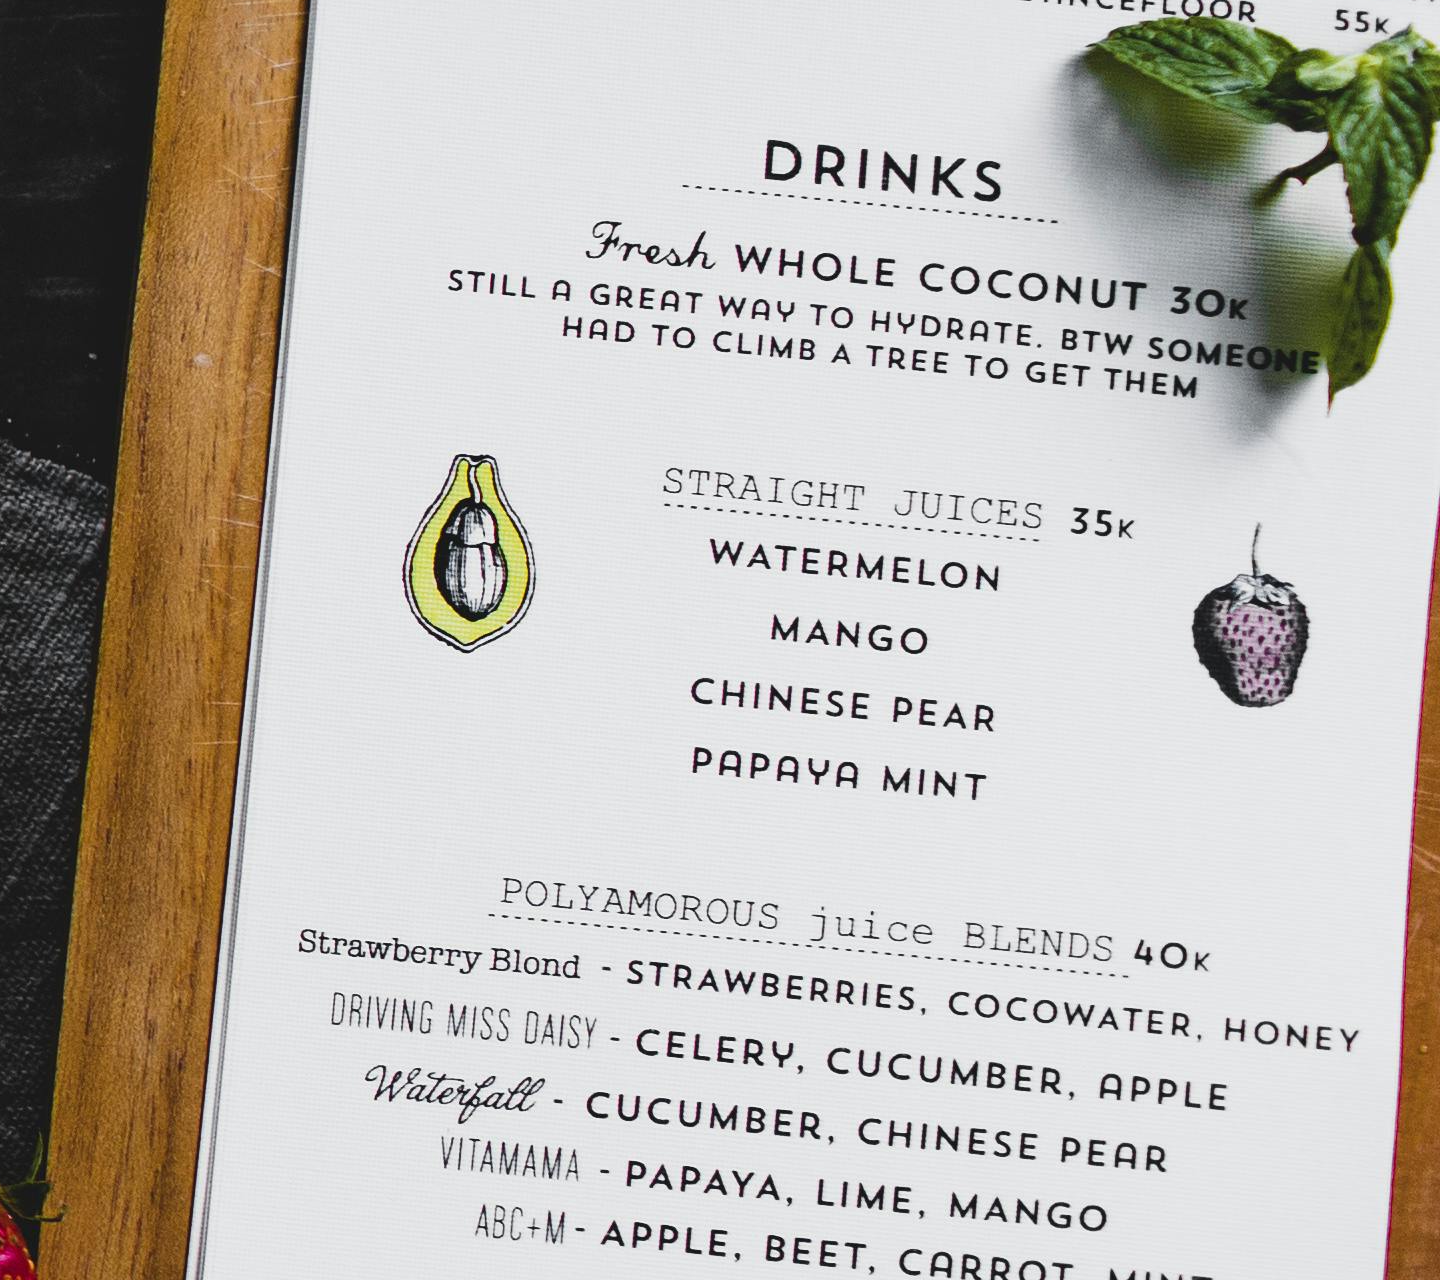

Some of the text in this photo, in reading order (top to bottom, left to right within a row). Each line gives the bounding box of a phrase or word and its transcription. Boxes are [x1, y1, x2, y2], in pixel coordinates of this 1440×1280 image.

[764, 139, 1002, 203] DRINKS
[585, 220, 717, 270] Fresh
[734, 244, 896, 288] WHOLE
[919, 262, 1148, 311] COCONUT
[447, 269, 1321, 375] STILL A GREAT WAY TO HYDRATE. BTW SOMEONE
[562, 315, 1198, 399] HAD TO CLIMB A TREE TO GET THEM
[662, 467, 865, 511] STRAIGHT
[894, 489, 1042, 529] JUICES
[709, 538, 1000, 592] WATERMELON
[770, 614, 928, 655] MANGO
[690, 677, 994, 733] CHINESE PEAR
[691, 746, 987, 801] PAPAYA MINT
[500, 877, 779, 930] POLYAMOROUS
[809, 905, 934, 945] juice
[963, 922, 1113, 962] BLENDS
[297, 928, 483, 975] Strawberry
[488, 947, 582, 979] Blond
[626, 959, 926, 1016] STRAWBERRIES,
[948, 991, 1202, 1041] COCOWATER,
[1224, 1017, 1360, 1053] HONEY
[331, 991, 433, 1035] DRIVING
[446, 1003, 511, 1042] MISS
[524, 1010, 597, 1049] DAISY
[636, 1028, 804, 1075] CELERY,
[826, 1047, 1075, 1101] CUCUMBER,
[1099, 1073, 1228, 1111] APPLE
[364, 1064, 547, 1125] Waterfall
[586, 1091, 835, 1145] CUCUMBER,
[857, 1117, 1039, 1161] CHINESE
[1060, 1136, 1167, 1173] PEAR
[441, 1135, 579, 1182] VITAMAMA
[626, 1160, 793, 1207] PAPAYA,
[816, 1178, 925, 1220] LIME,
[949, 1191, 1108, 1232] MANGO
[474, 1204, 566, 1245] ABC+M
[600, 1219, 741, 1263] APPLE,
[765, 1234, 875, 1275] BEET,
